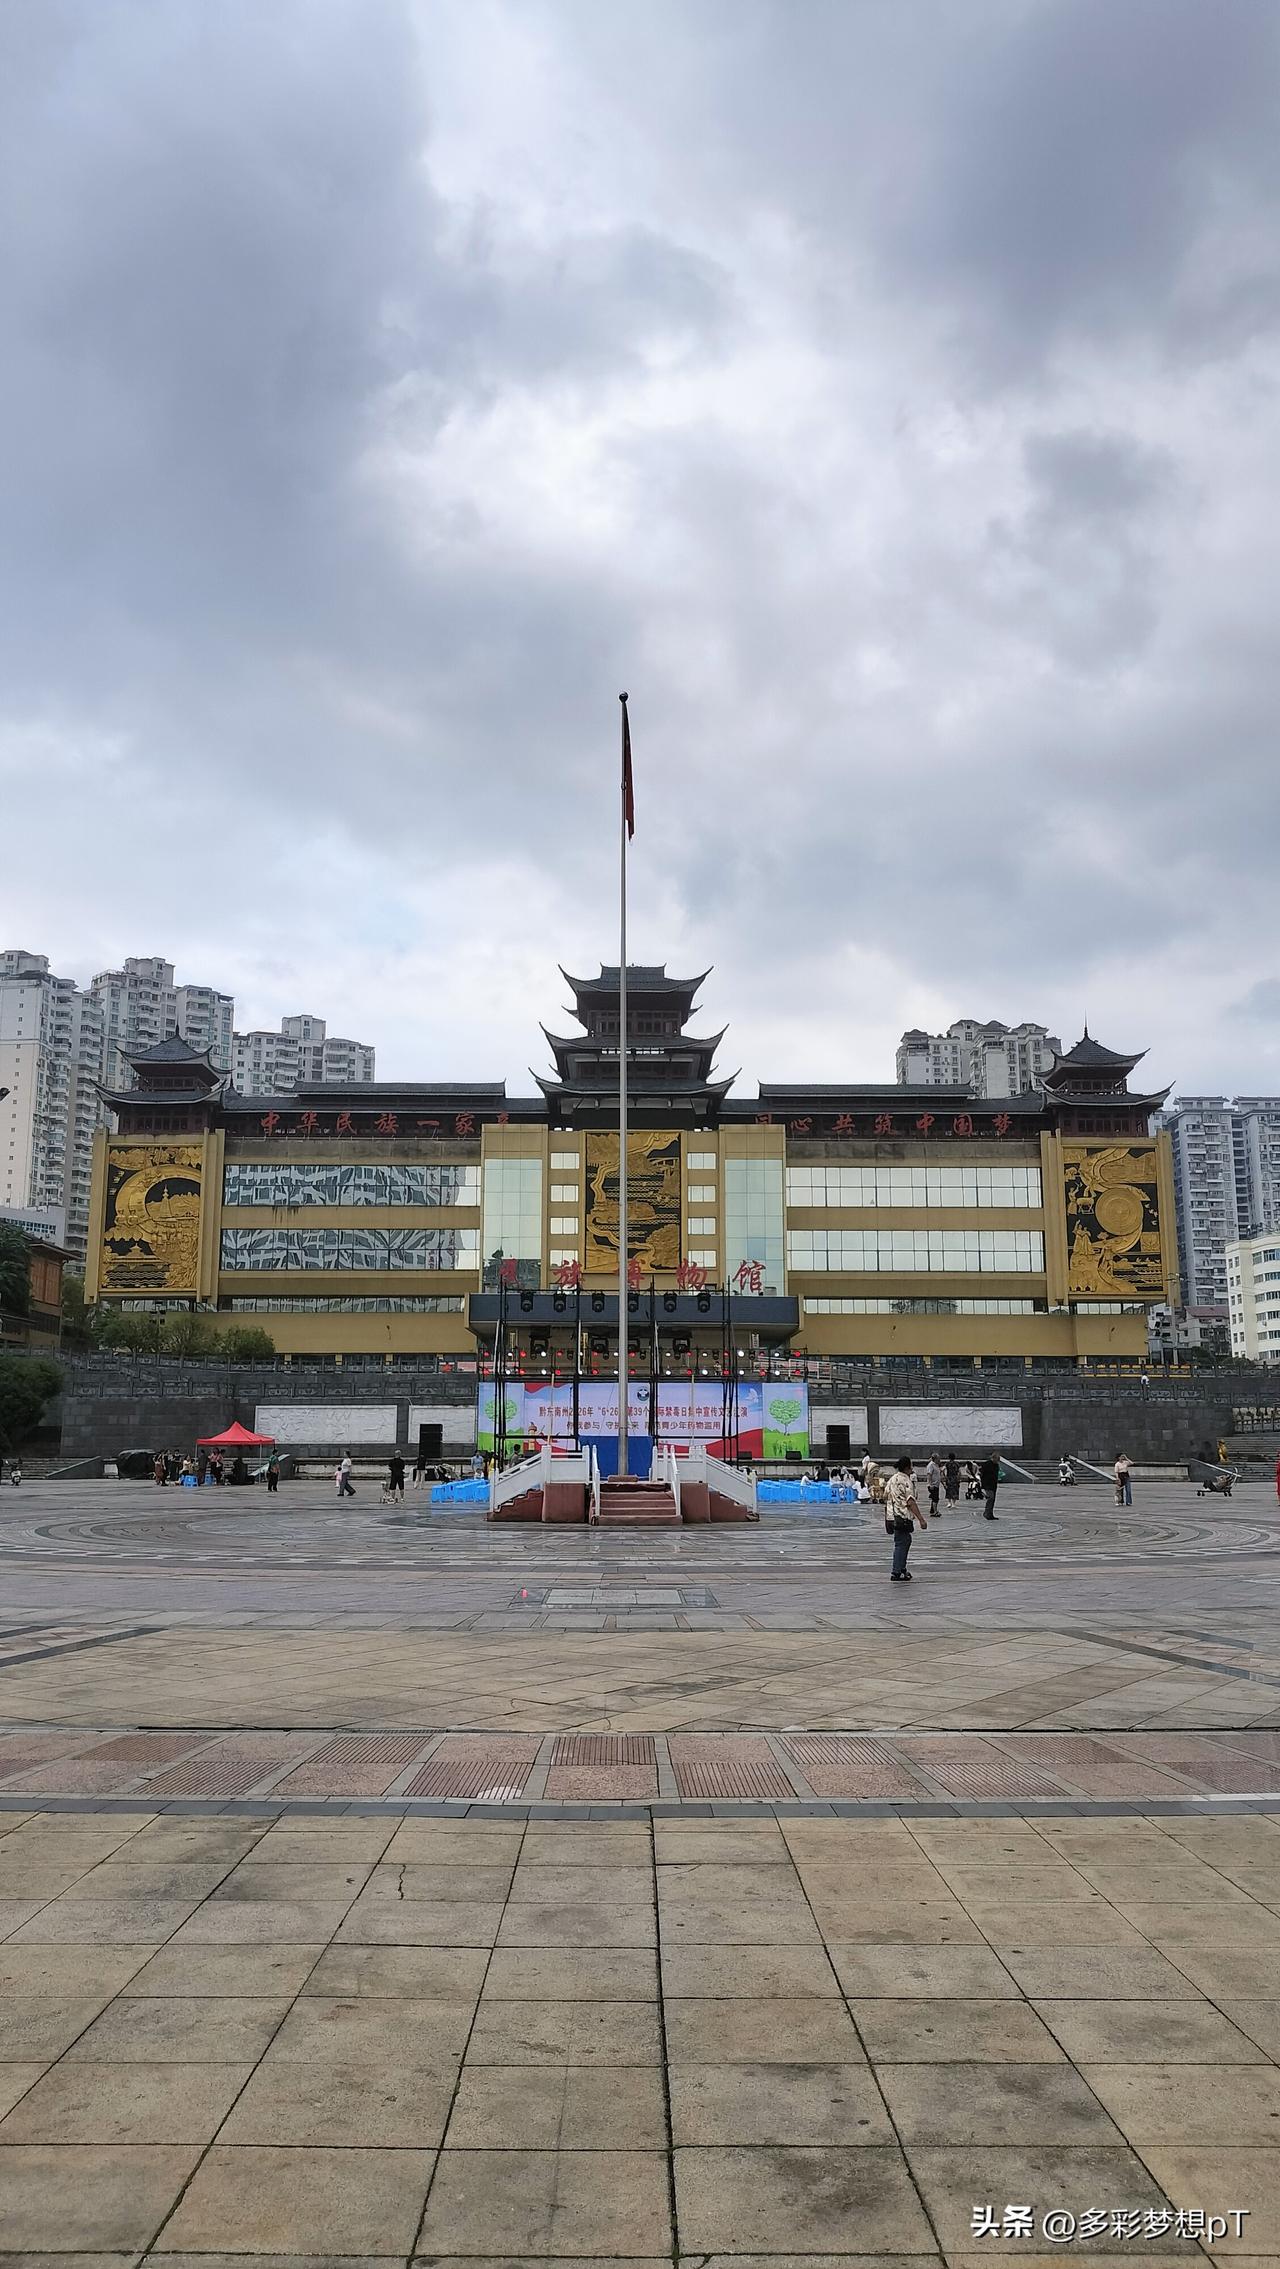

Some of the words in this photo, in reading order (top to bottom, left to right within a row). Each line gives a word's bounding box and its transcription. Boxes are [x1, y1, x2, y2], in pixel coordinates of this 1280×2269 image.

[499, 1258, 767, 1293] 民族博物馆
[605, 1421, 639, 1430] 守护来
